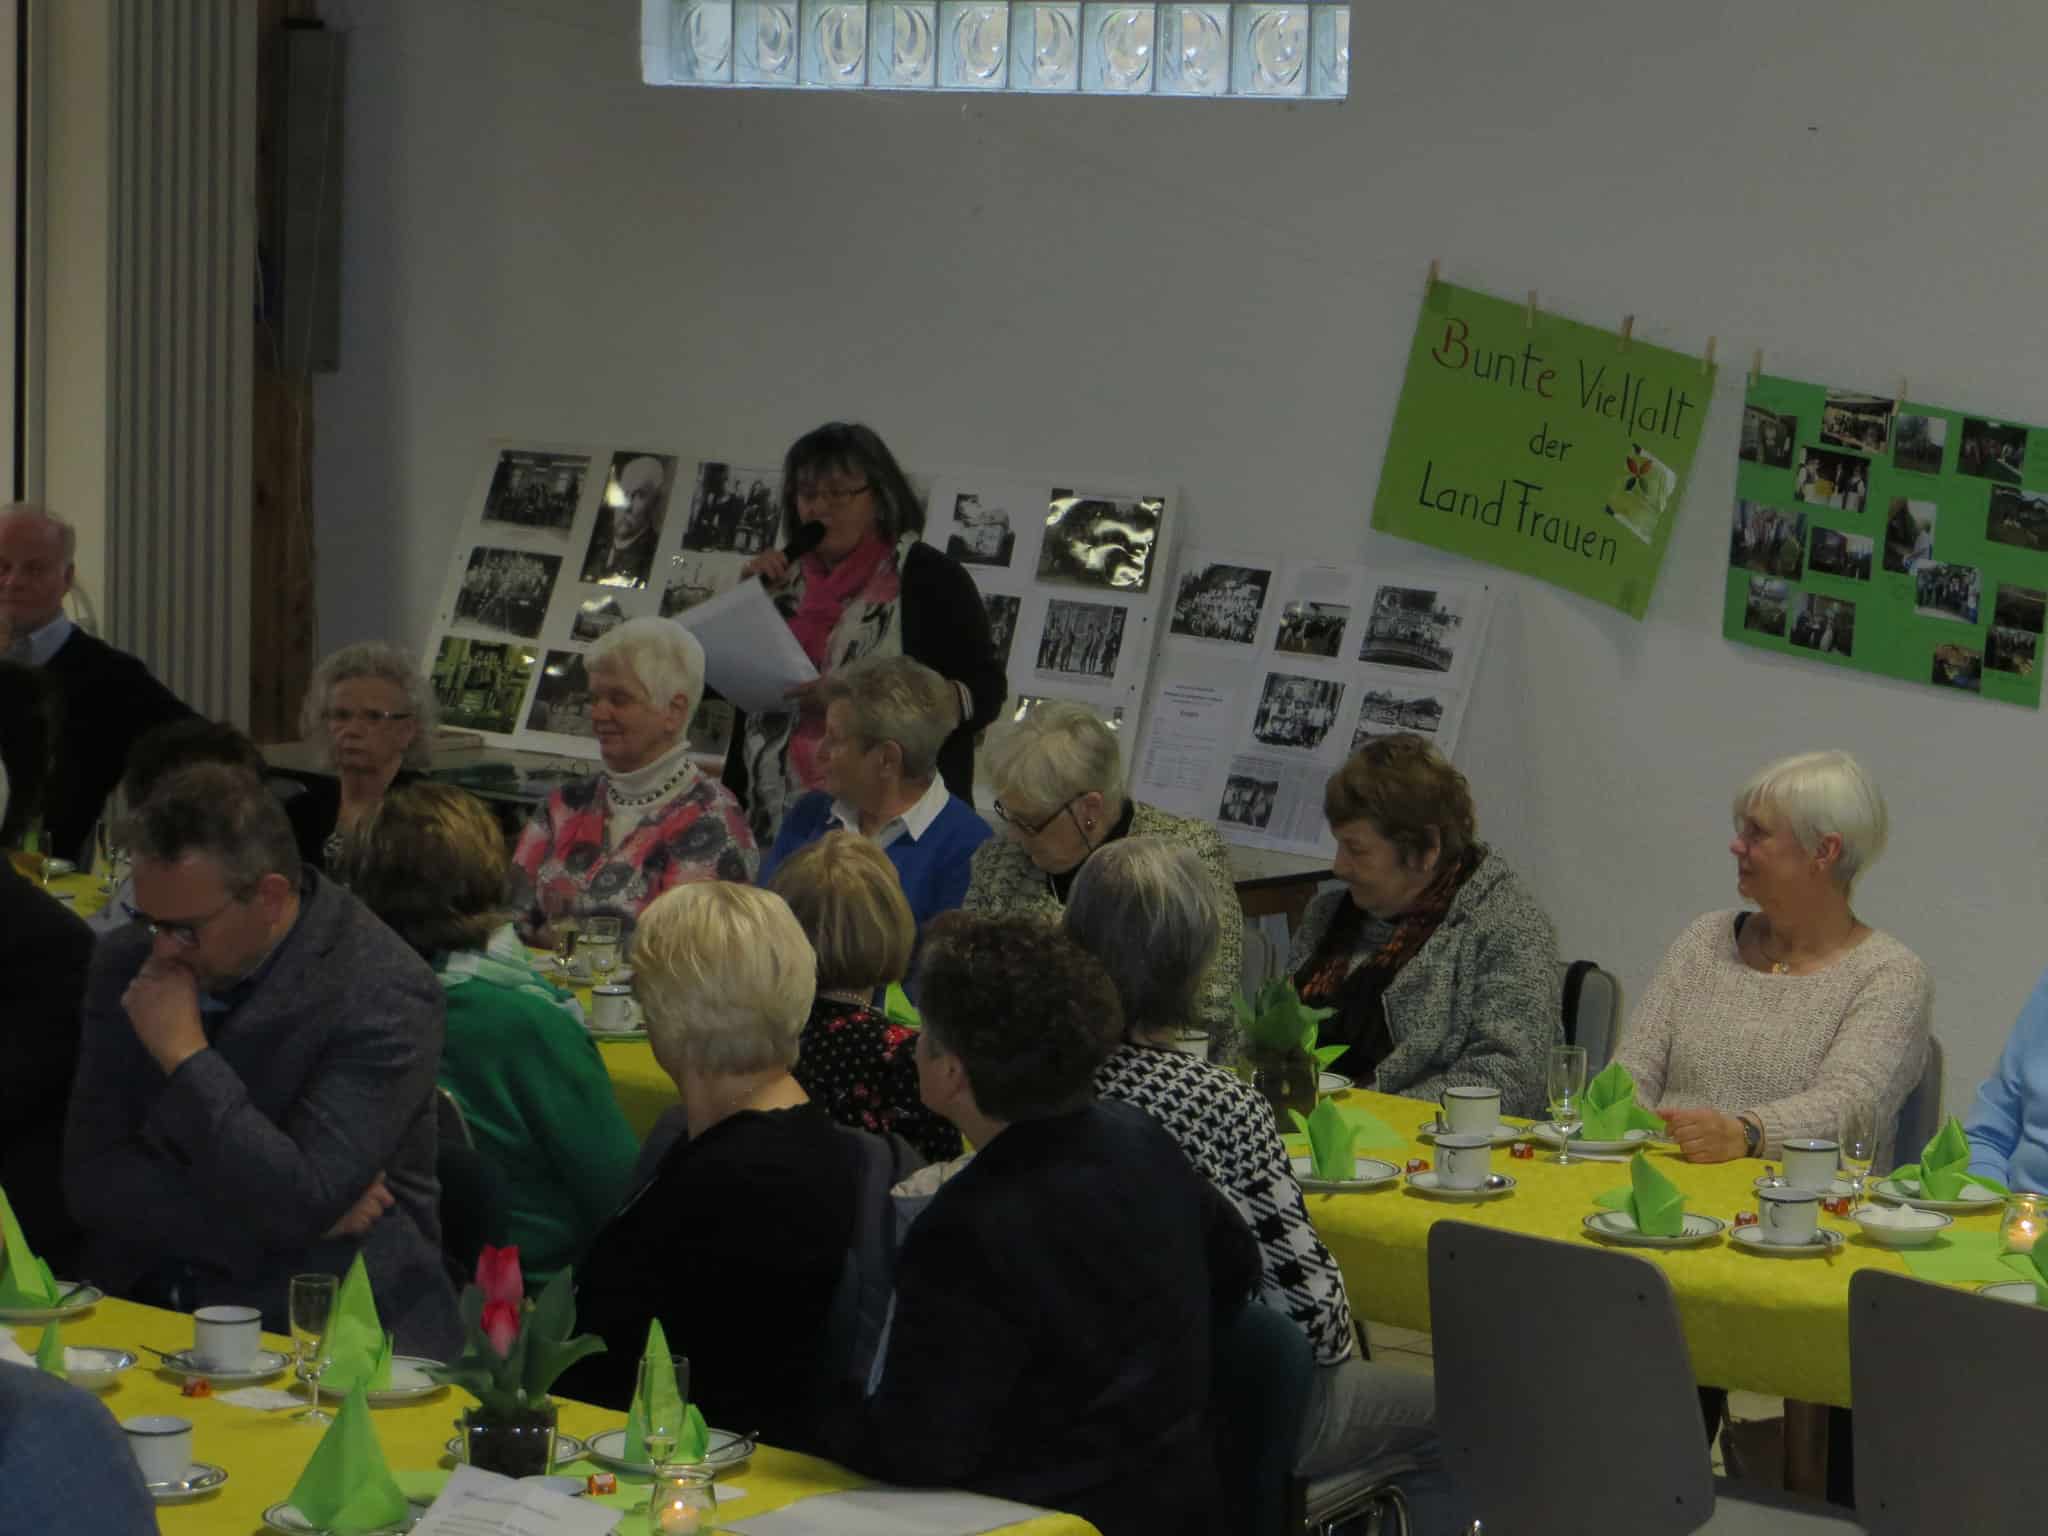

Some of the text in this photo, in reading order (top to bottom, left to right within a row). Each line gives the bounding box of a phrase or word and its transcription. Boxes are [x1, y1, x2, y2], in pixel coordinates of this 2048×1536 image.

[1432, 318, 1695, 440] Bunte Vielfalt
[1529, 422, 1573, 461] der
